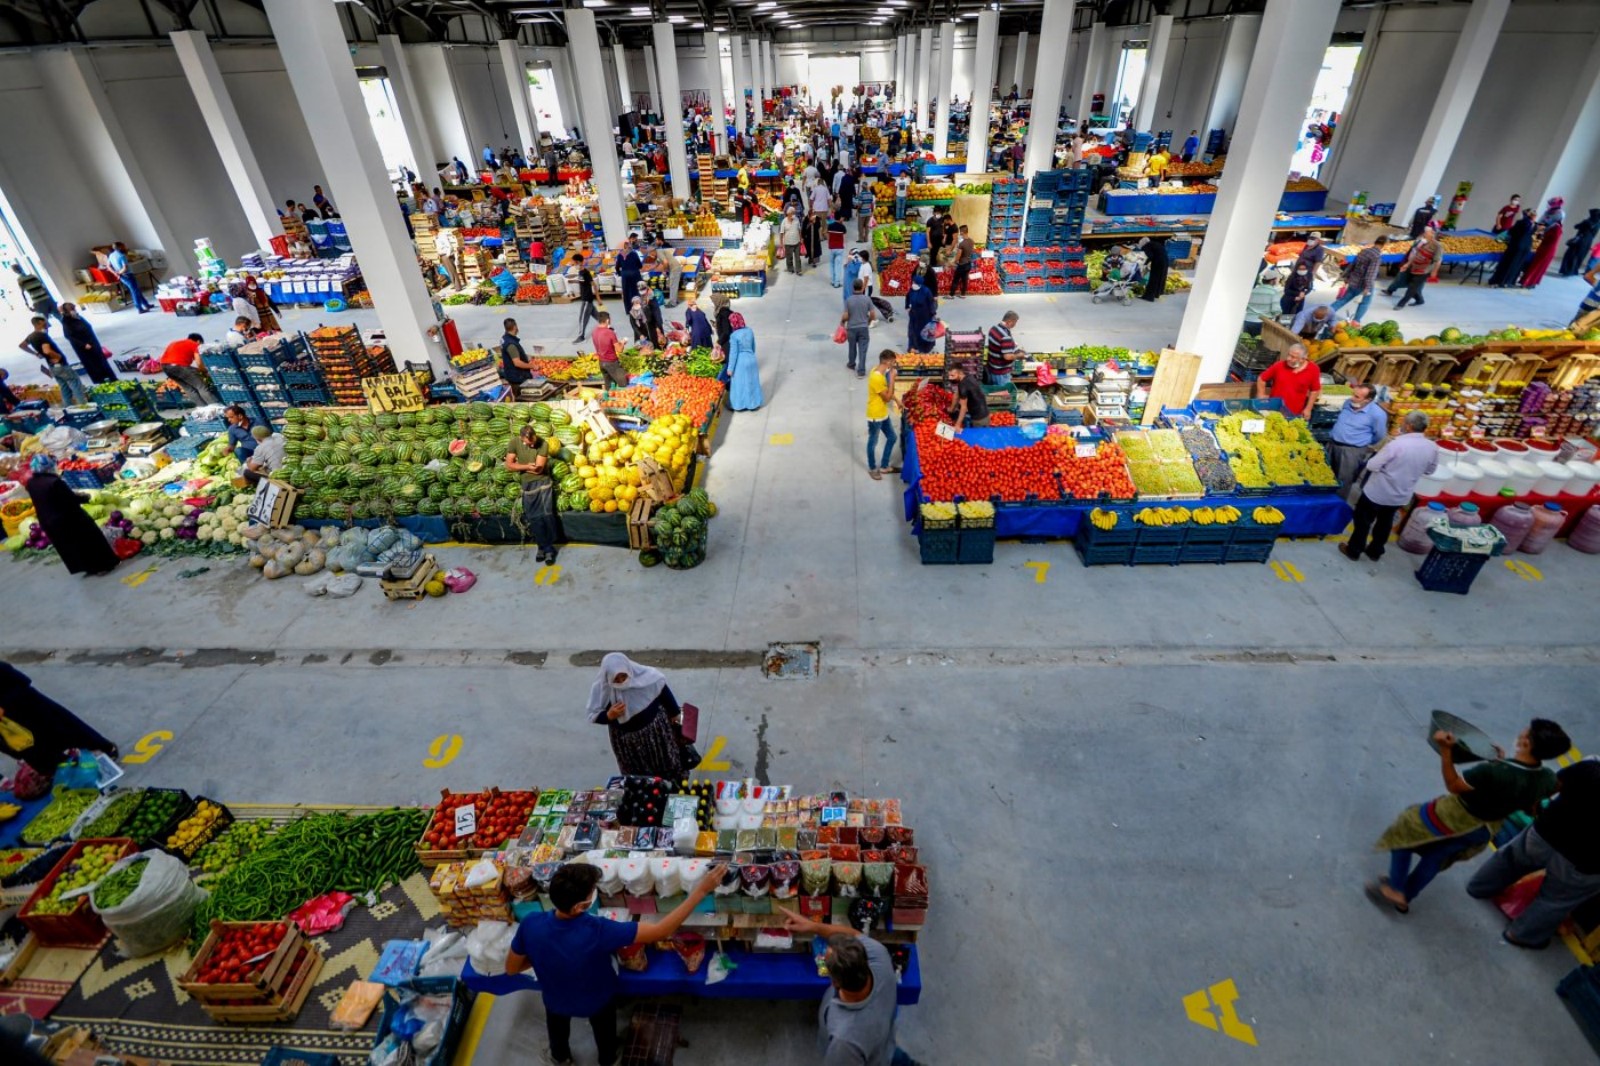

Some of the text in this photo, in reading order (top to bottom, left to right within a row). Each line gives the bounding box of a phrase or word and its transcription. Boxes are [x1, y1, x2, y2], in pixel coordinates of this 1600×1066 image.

[384, 385, 413, 398] BAL
[1024, 561, 1051, 585] 7
[457, 811, 474, 832] 15
[1181, 977, 1260, 1047] A
